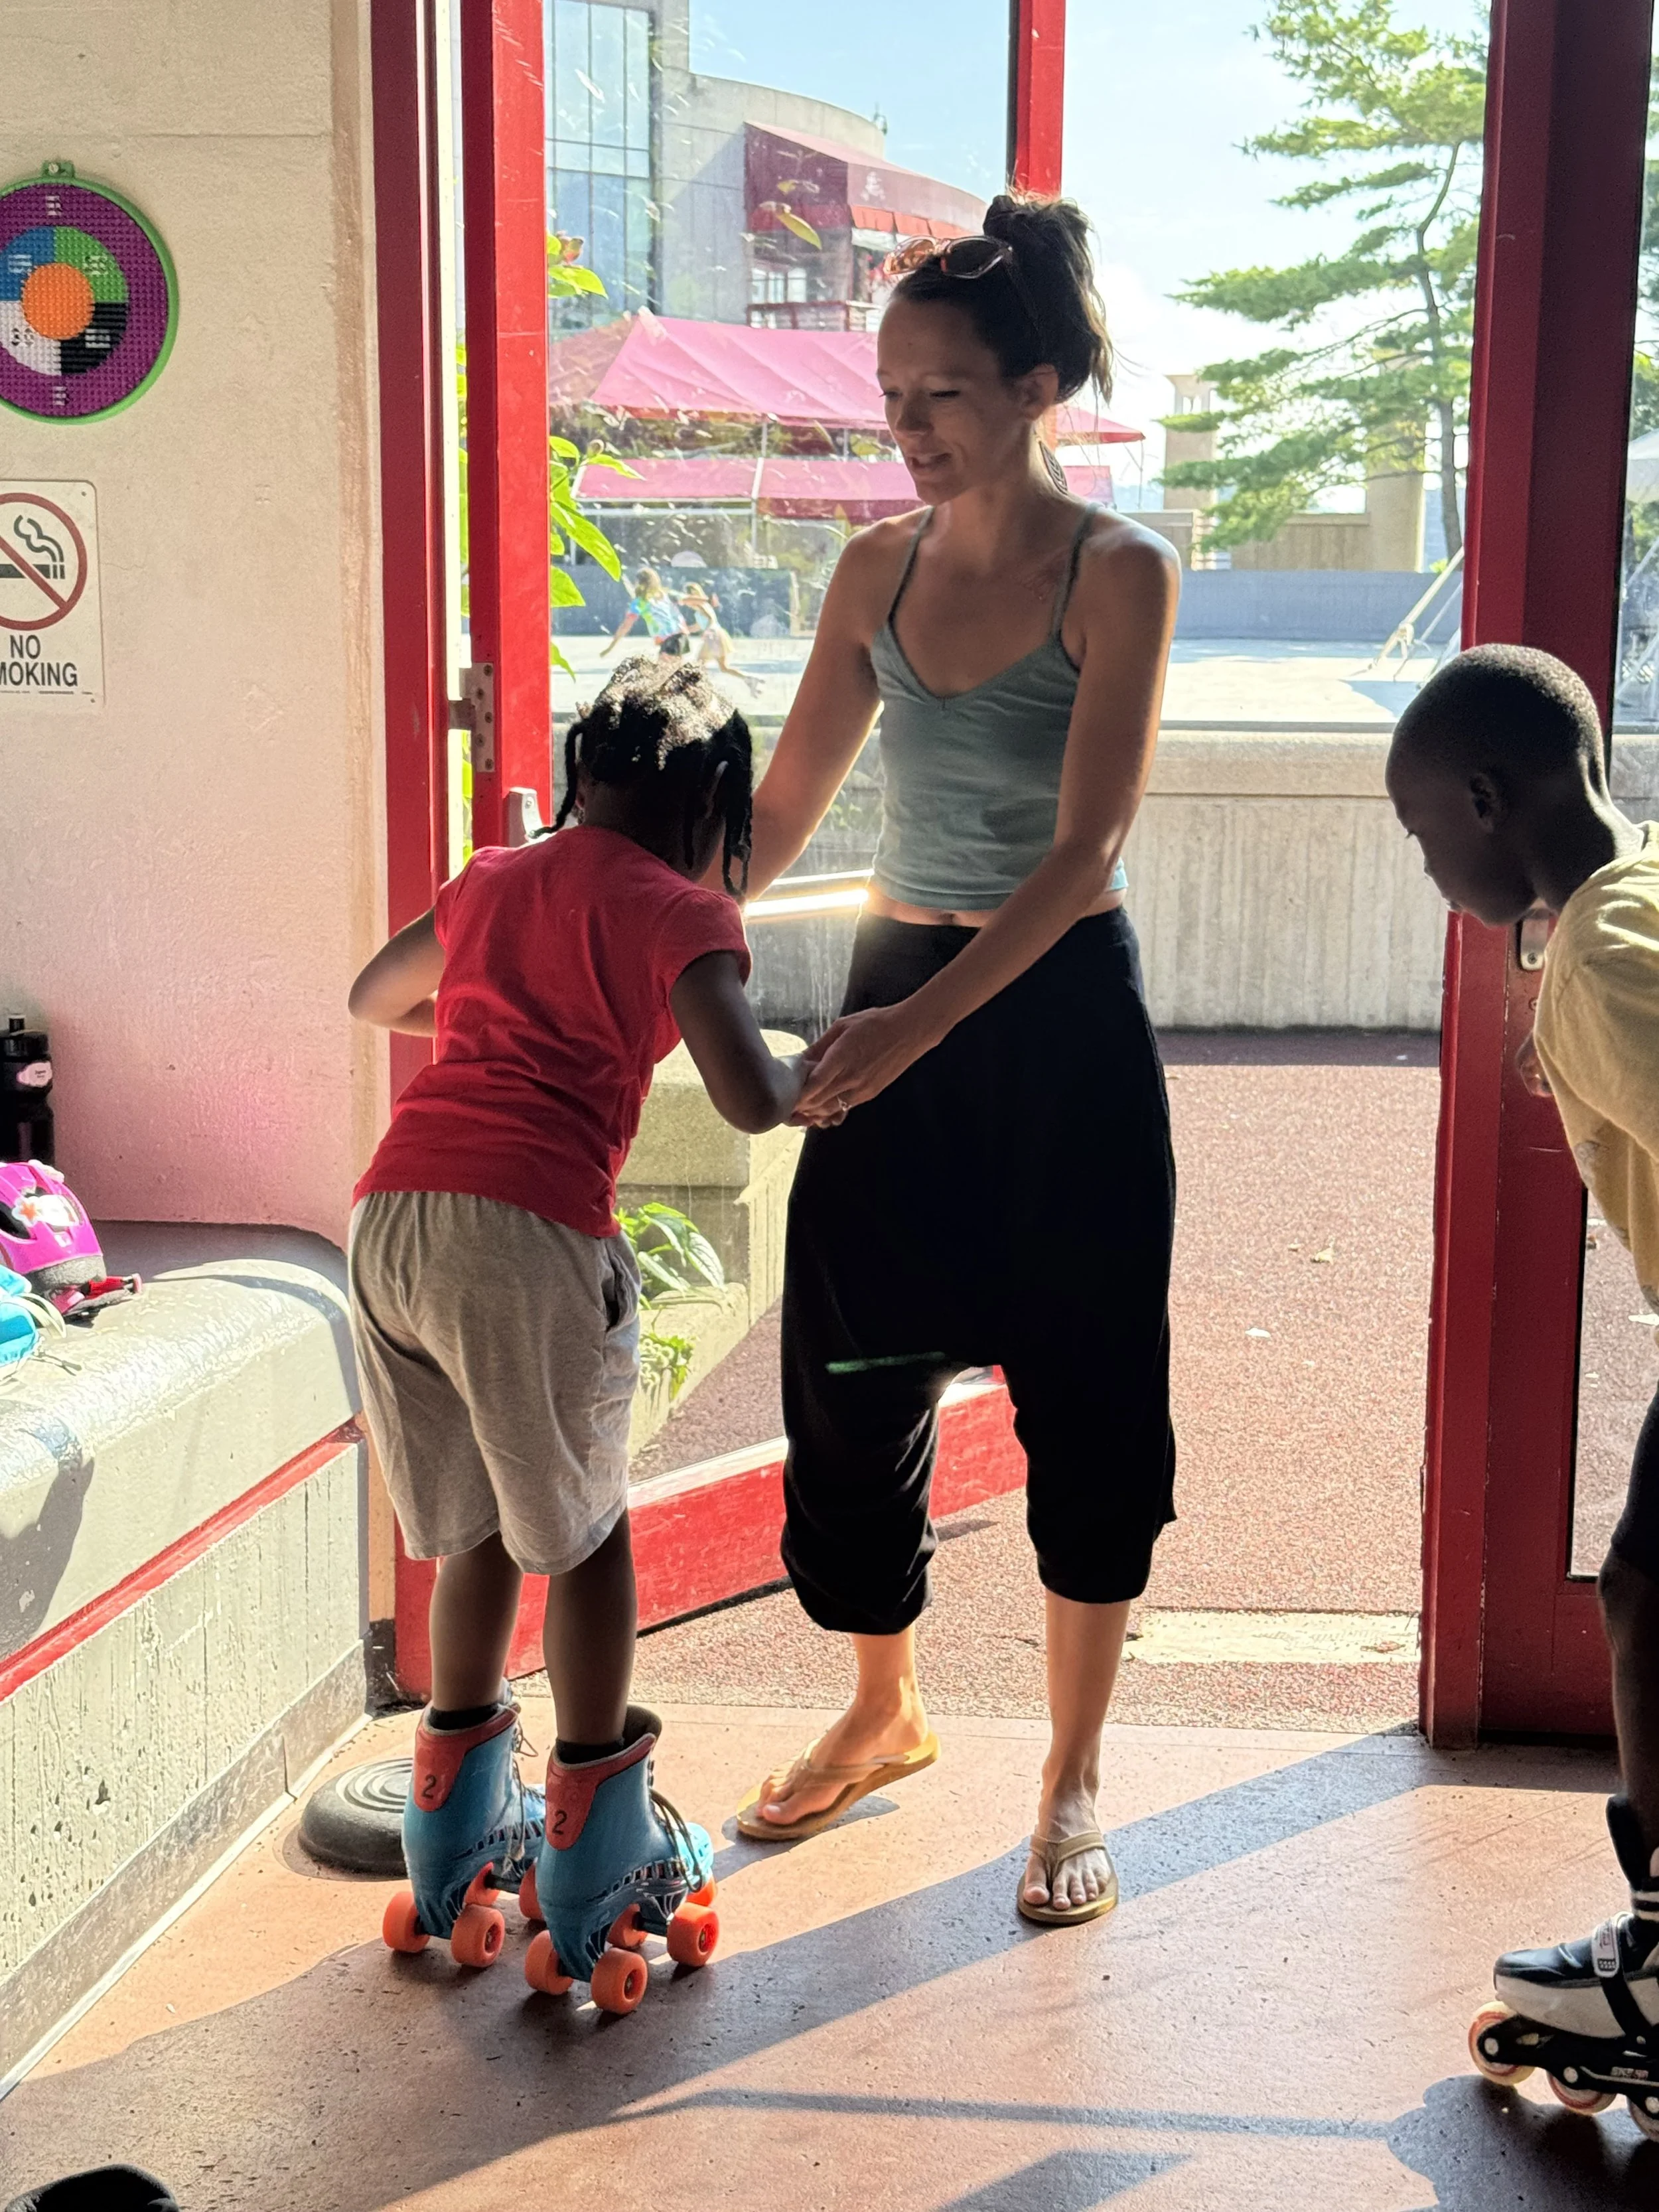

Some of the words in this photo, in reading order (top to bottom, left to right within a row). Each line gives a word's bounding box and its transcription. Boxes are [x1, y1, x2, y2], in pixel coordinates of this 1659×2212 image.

[10, 634, 41, 659] NO
[421, 1774, 437, 1799] 2
[552, 1809, 567, 1836] 2
